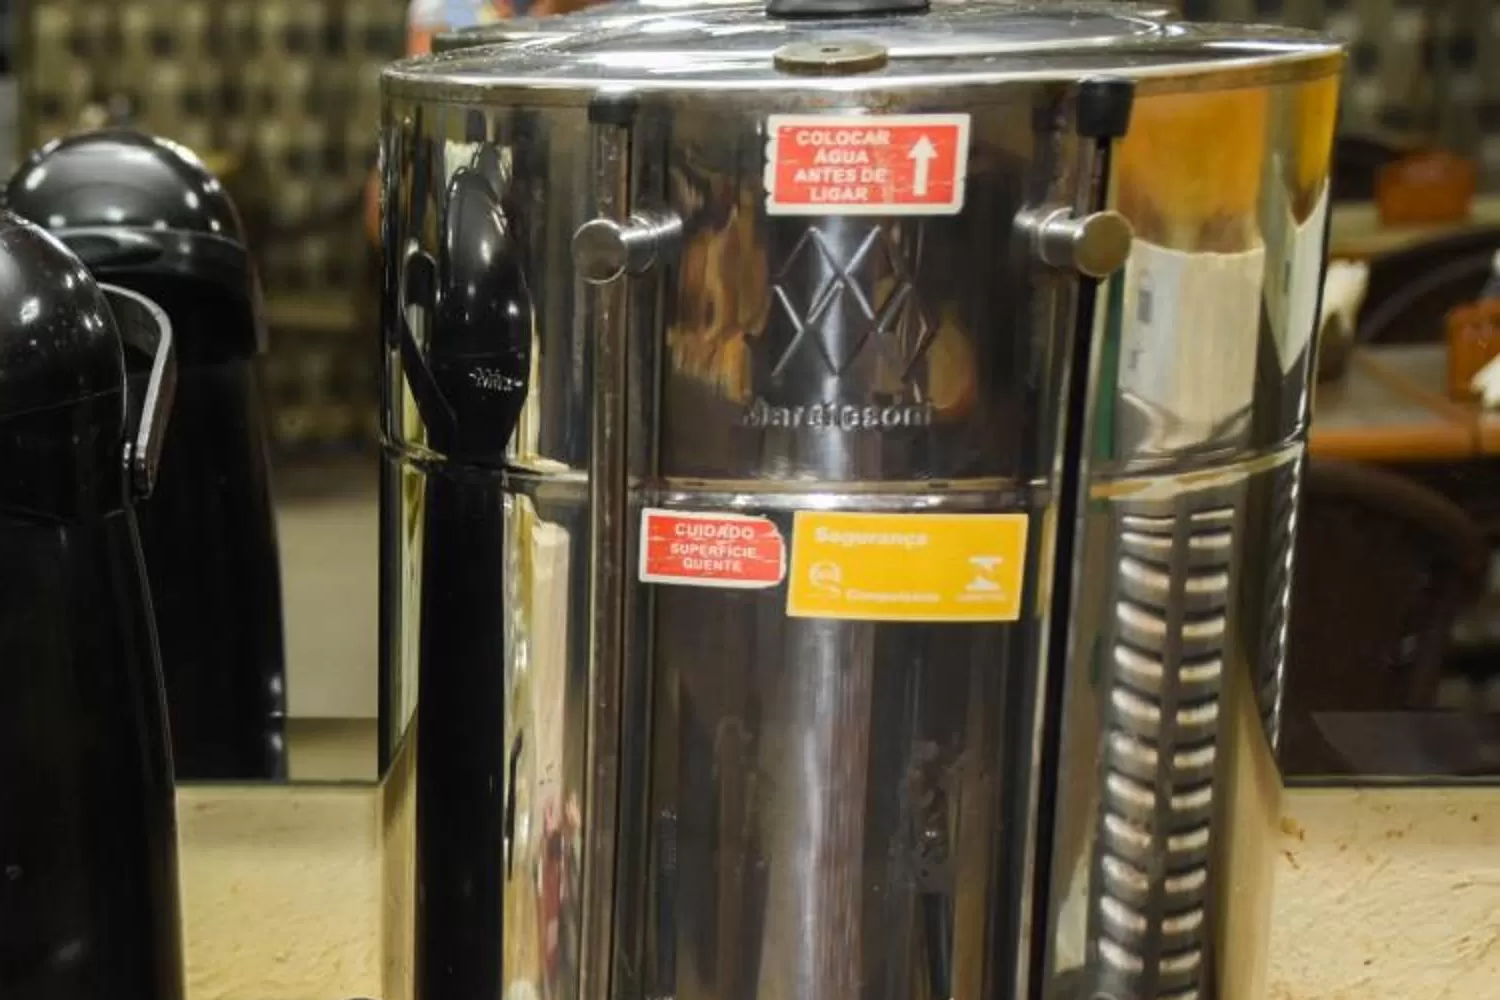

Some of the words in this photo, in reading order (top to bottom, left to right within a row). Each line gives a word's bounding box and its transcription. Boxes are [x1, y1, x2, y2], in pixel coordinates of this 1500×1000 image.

[796, 131, 891, 146] COLOCAR
[794, 168, 855, 183] ANTES
[860, 167, 888, 183] DE
[810, 187, 869, 202] LIGAR
[674, 523, 755, 541] CUIDADO
[682, 557, 742, 573] QUENTE
